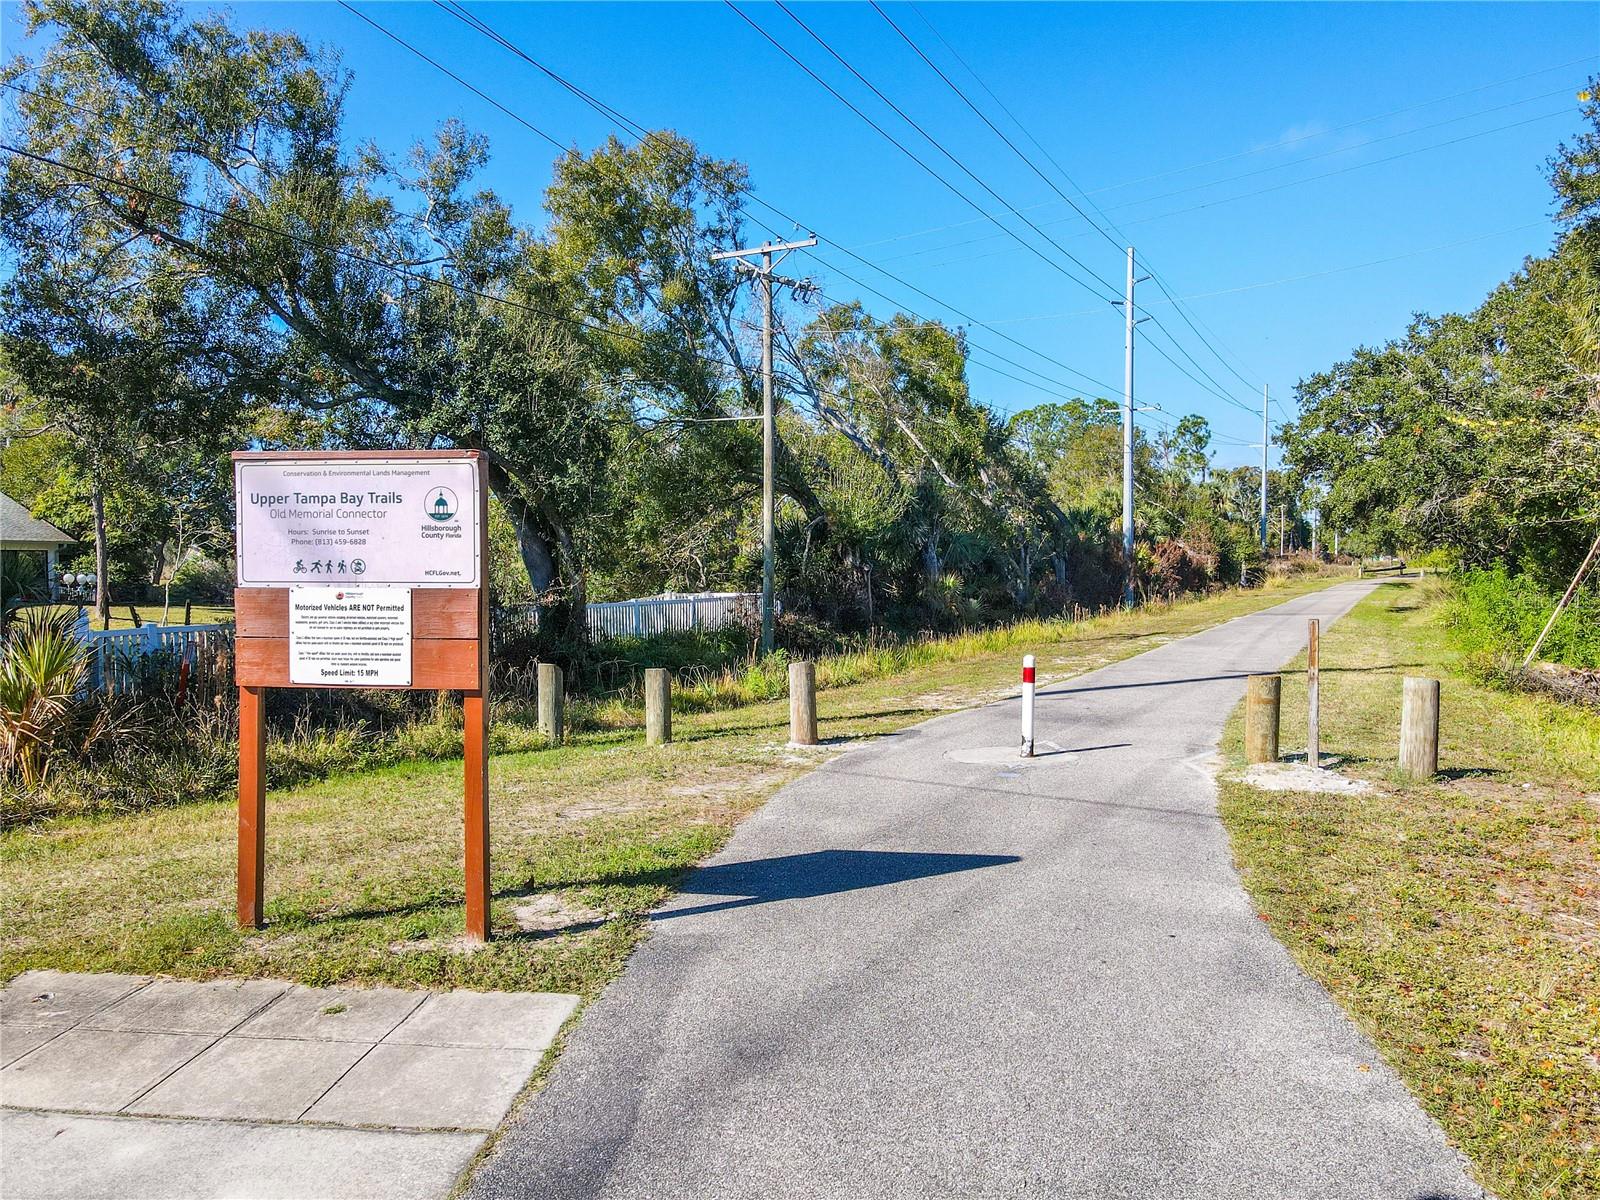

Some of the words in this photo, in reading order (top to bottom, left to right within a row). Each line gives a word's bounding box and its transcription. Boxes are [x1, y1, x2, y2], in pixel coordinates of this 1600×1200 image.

[328, 469, 371, 477] Environmental
[391, 469, 430, 478] Management
[250, 492, 289, 507] Upper
[293, 492, 336, 507] Tampa
[340, 492, 364, 507] Bay
[367, 491, 403, 504] Trails
[270, 509, 286, 518] Old
[288, 508, 333, 519] Memorial
[336, 508, 387, 518] Connector
[287, 528, 309, 536] Hours:
[421, 525, 461, 533] Hillsborough
[421, 532, 444, 540] County
[315, 538, 333, 546] (813)
[295, 603, 322, 611] Motorized
[323, 603, 347, 611] Vehicles
[320, 668, 338, 677] Speed
[357, 669, 364, 677] 15
[365, 669, 379, 677] MPH
